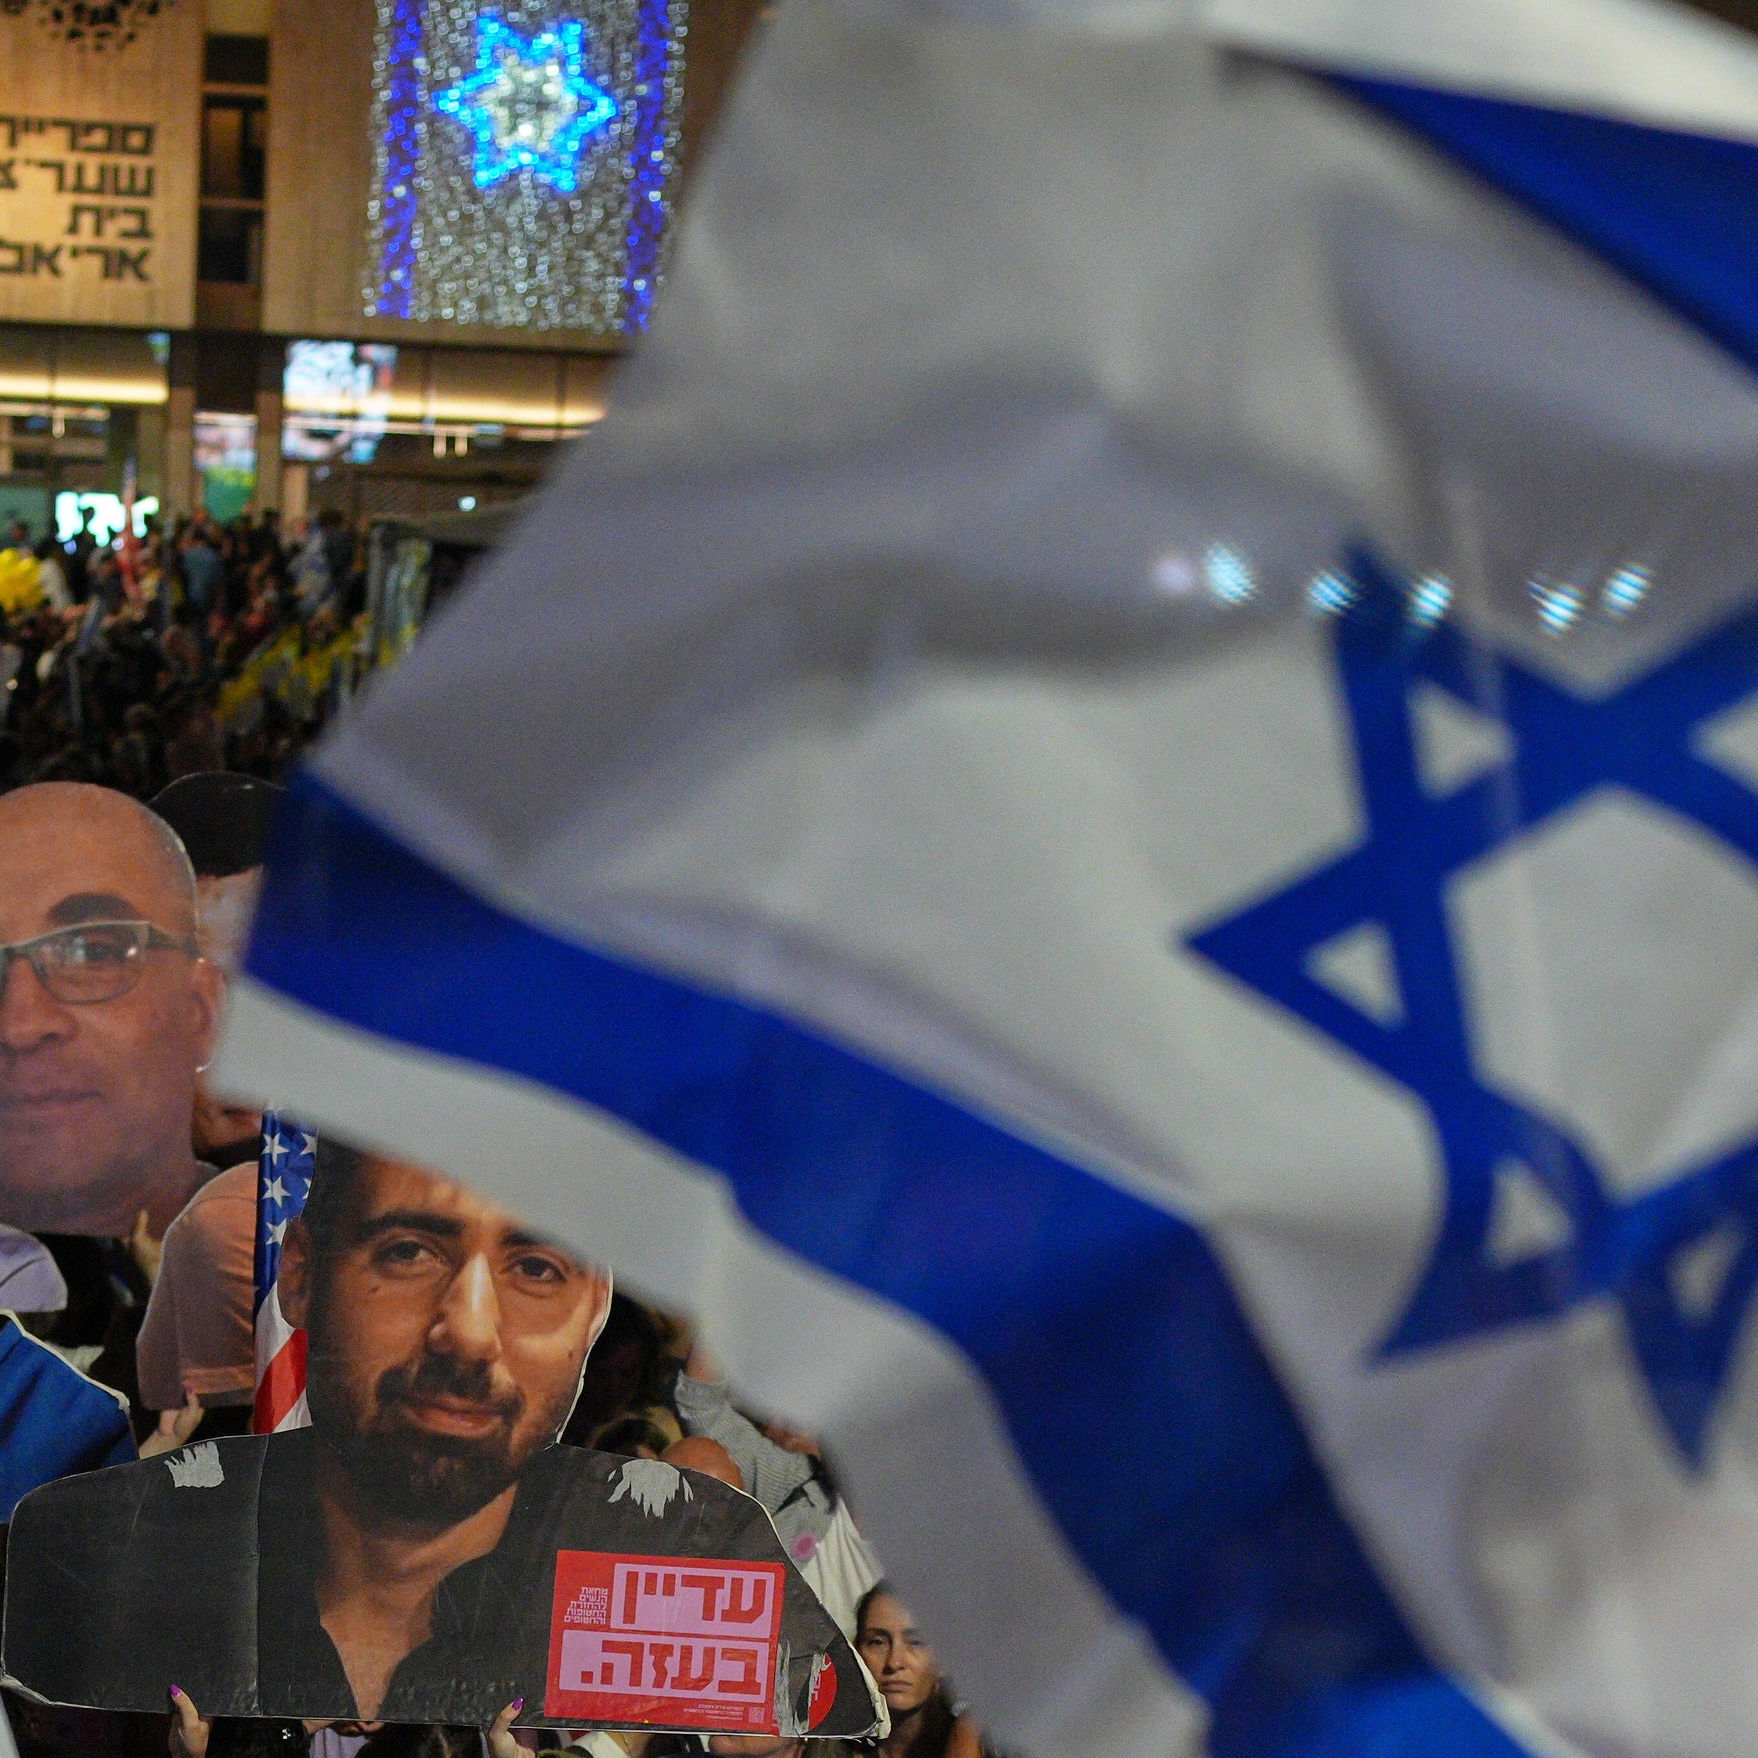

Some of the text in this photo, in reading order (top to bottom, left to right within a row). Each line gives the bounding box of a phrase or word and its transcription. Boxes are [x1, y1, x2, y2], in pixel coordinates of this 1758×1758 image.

[67, 203, 154, 238] בית
[581, 1586, 608, 1595] מחאת
[622, 1570, 767, 1624] עדיין
[580, 1639, 762, 1696] בעזה.
